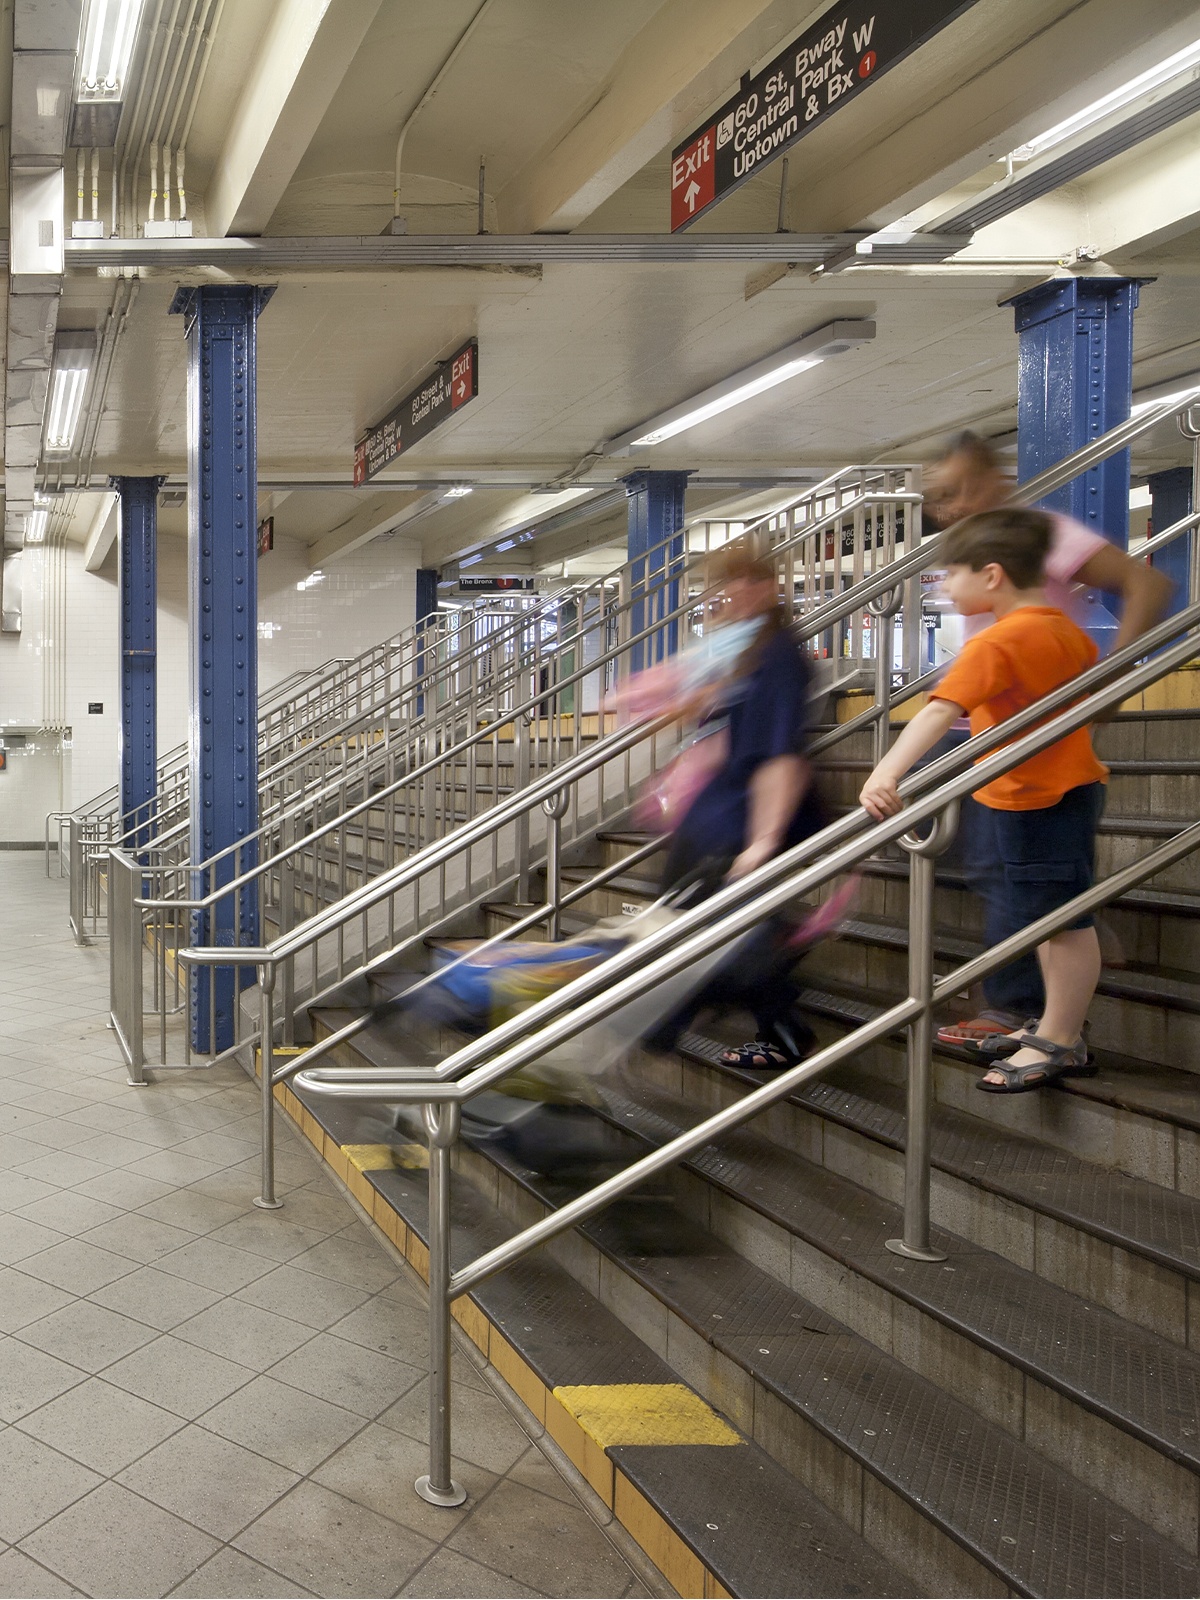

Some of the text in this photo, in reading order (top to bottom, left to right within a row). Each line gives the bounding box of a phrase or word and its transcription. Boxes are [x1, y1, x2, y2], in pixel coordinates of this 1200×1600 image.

[733, 15, 876, 152] Central Park W
[734, 17, 848, 128] 60 St, Bway
[733, 68, 854, 178] Uptown & Bx
[672, 135, 711, 190] Exit
[412, 375, 444, 412] 60 Street &
[452, 352, 470, 382] Exit
[411, 381, 452, 425] Central Park W
